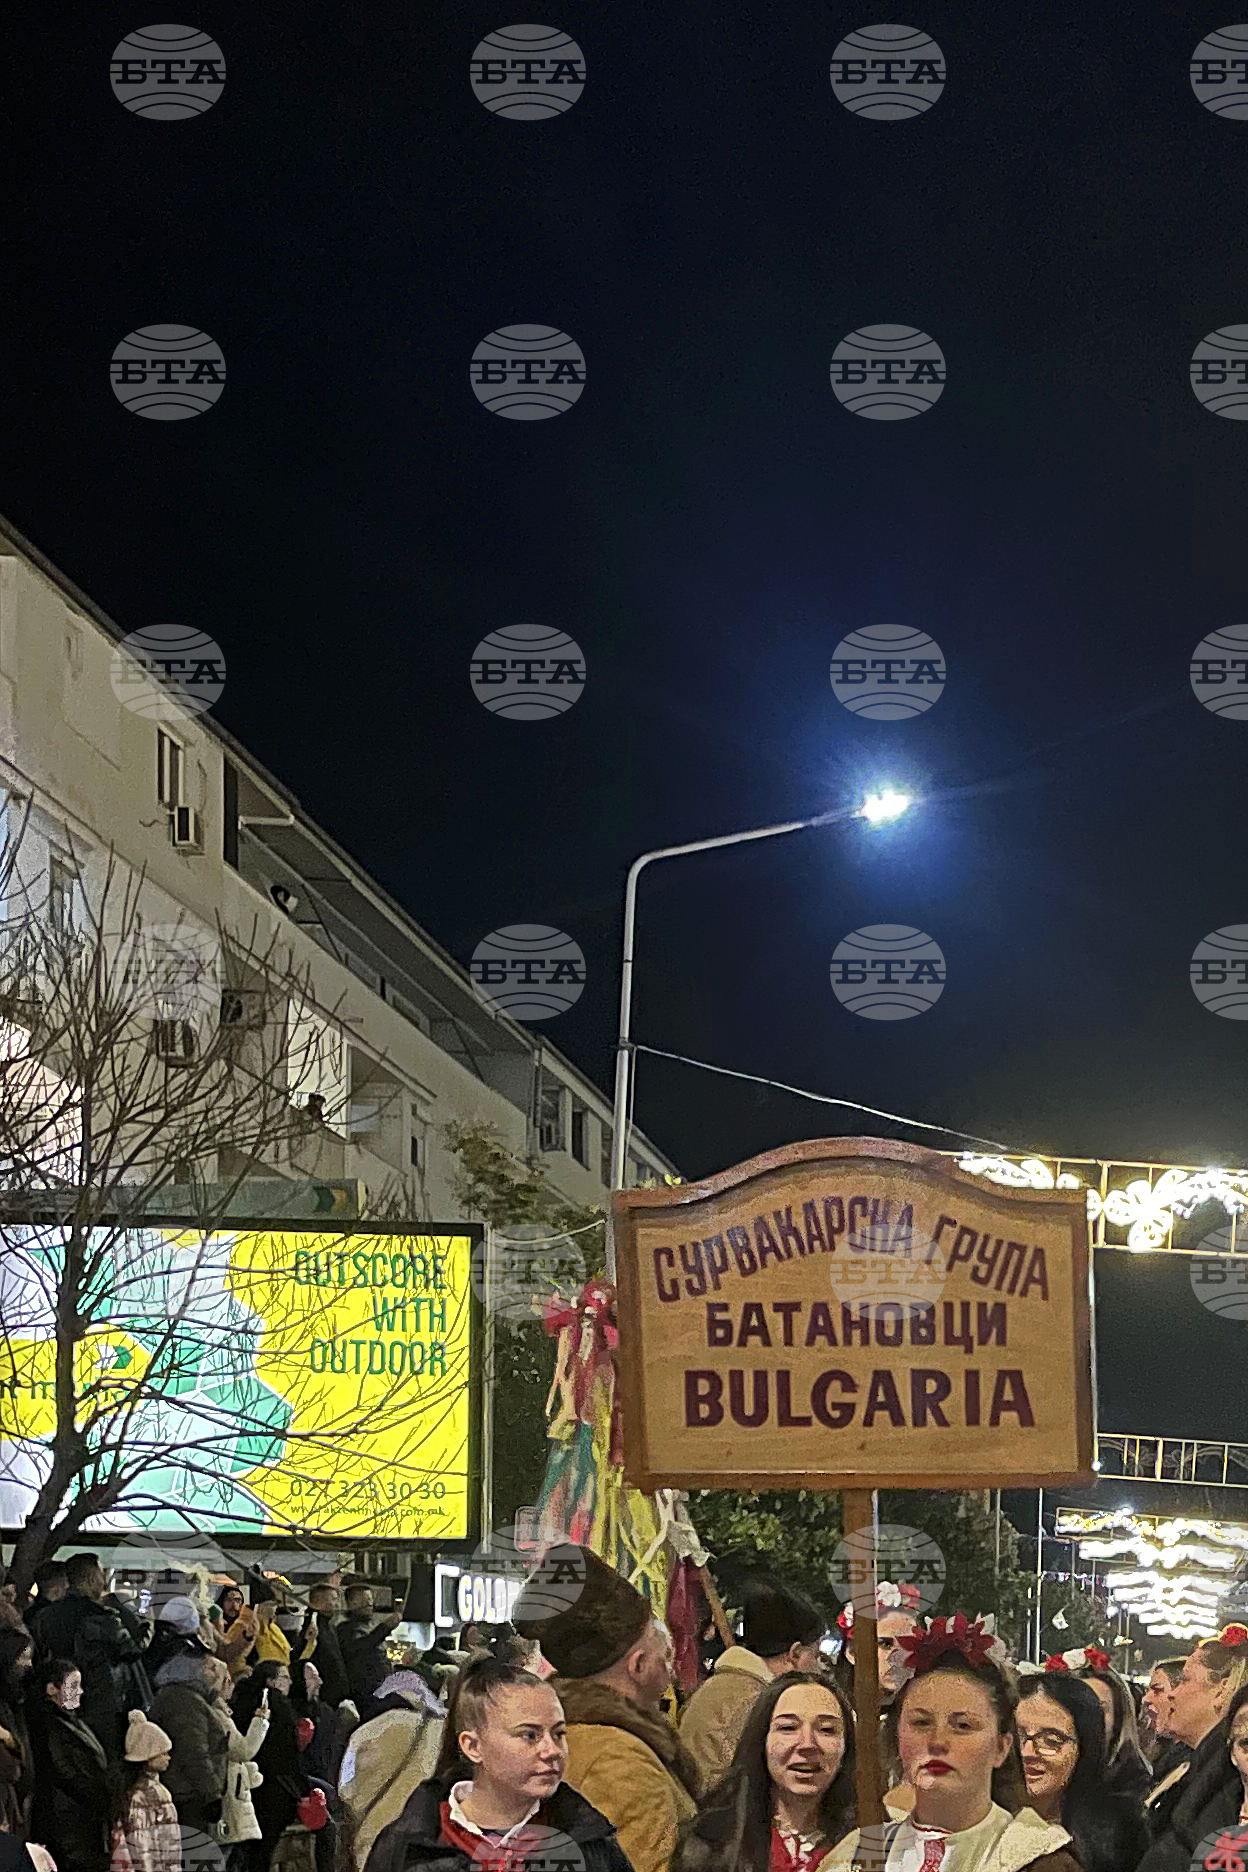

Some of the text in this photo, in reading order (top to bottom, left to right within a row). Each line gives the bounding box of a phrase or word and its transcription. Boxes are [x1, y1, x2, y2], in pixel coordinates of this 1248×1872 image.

[653, 1195, 1050, 1303] СУРВАКАРСКА ГРУПА
[295, 1250, 447, 1290] OUTSCORE
[371, 1296, 447, 1333] WITH
[707, 1301, 1008, 1355] БАТАНОВЦИ
[310, 1338, 447, 1377] OUTDOOR
[684, 1367, 1035, 1429] BULGARIA
[419, 1482, 446, 1500] 30
